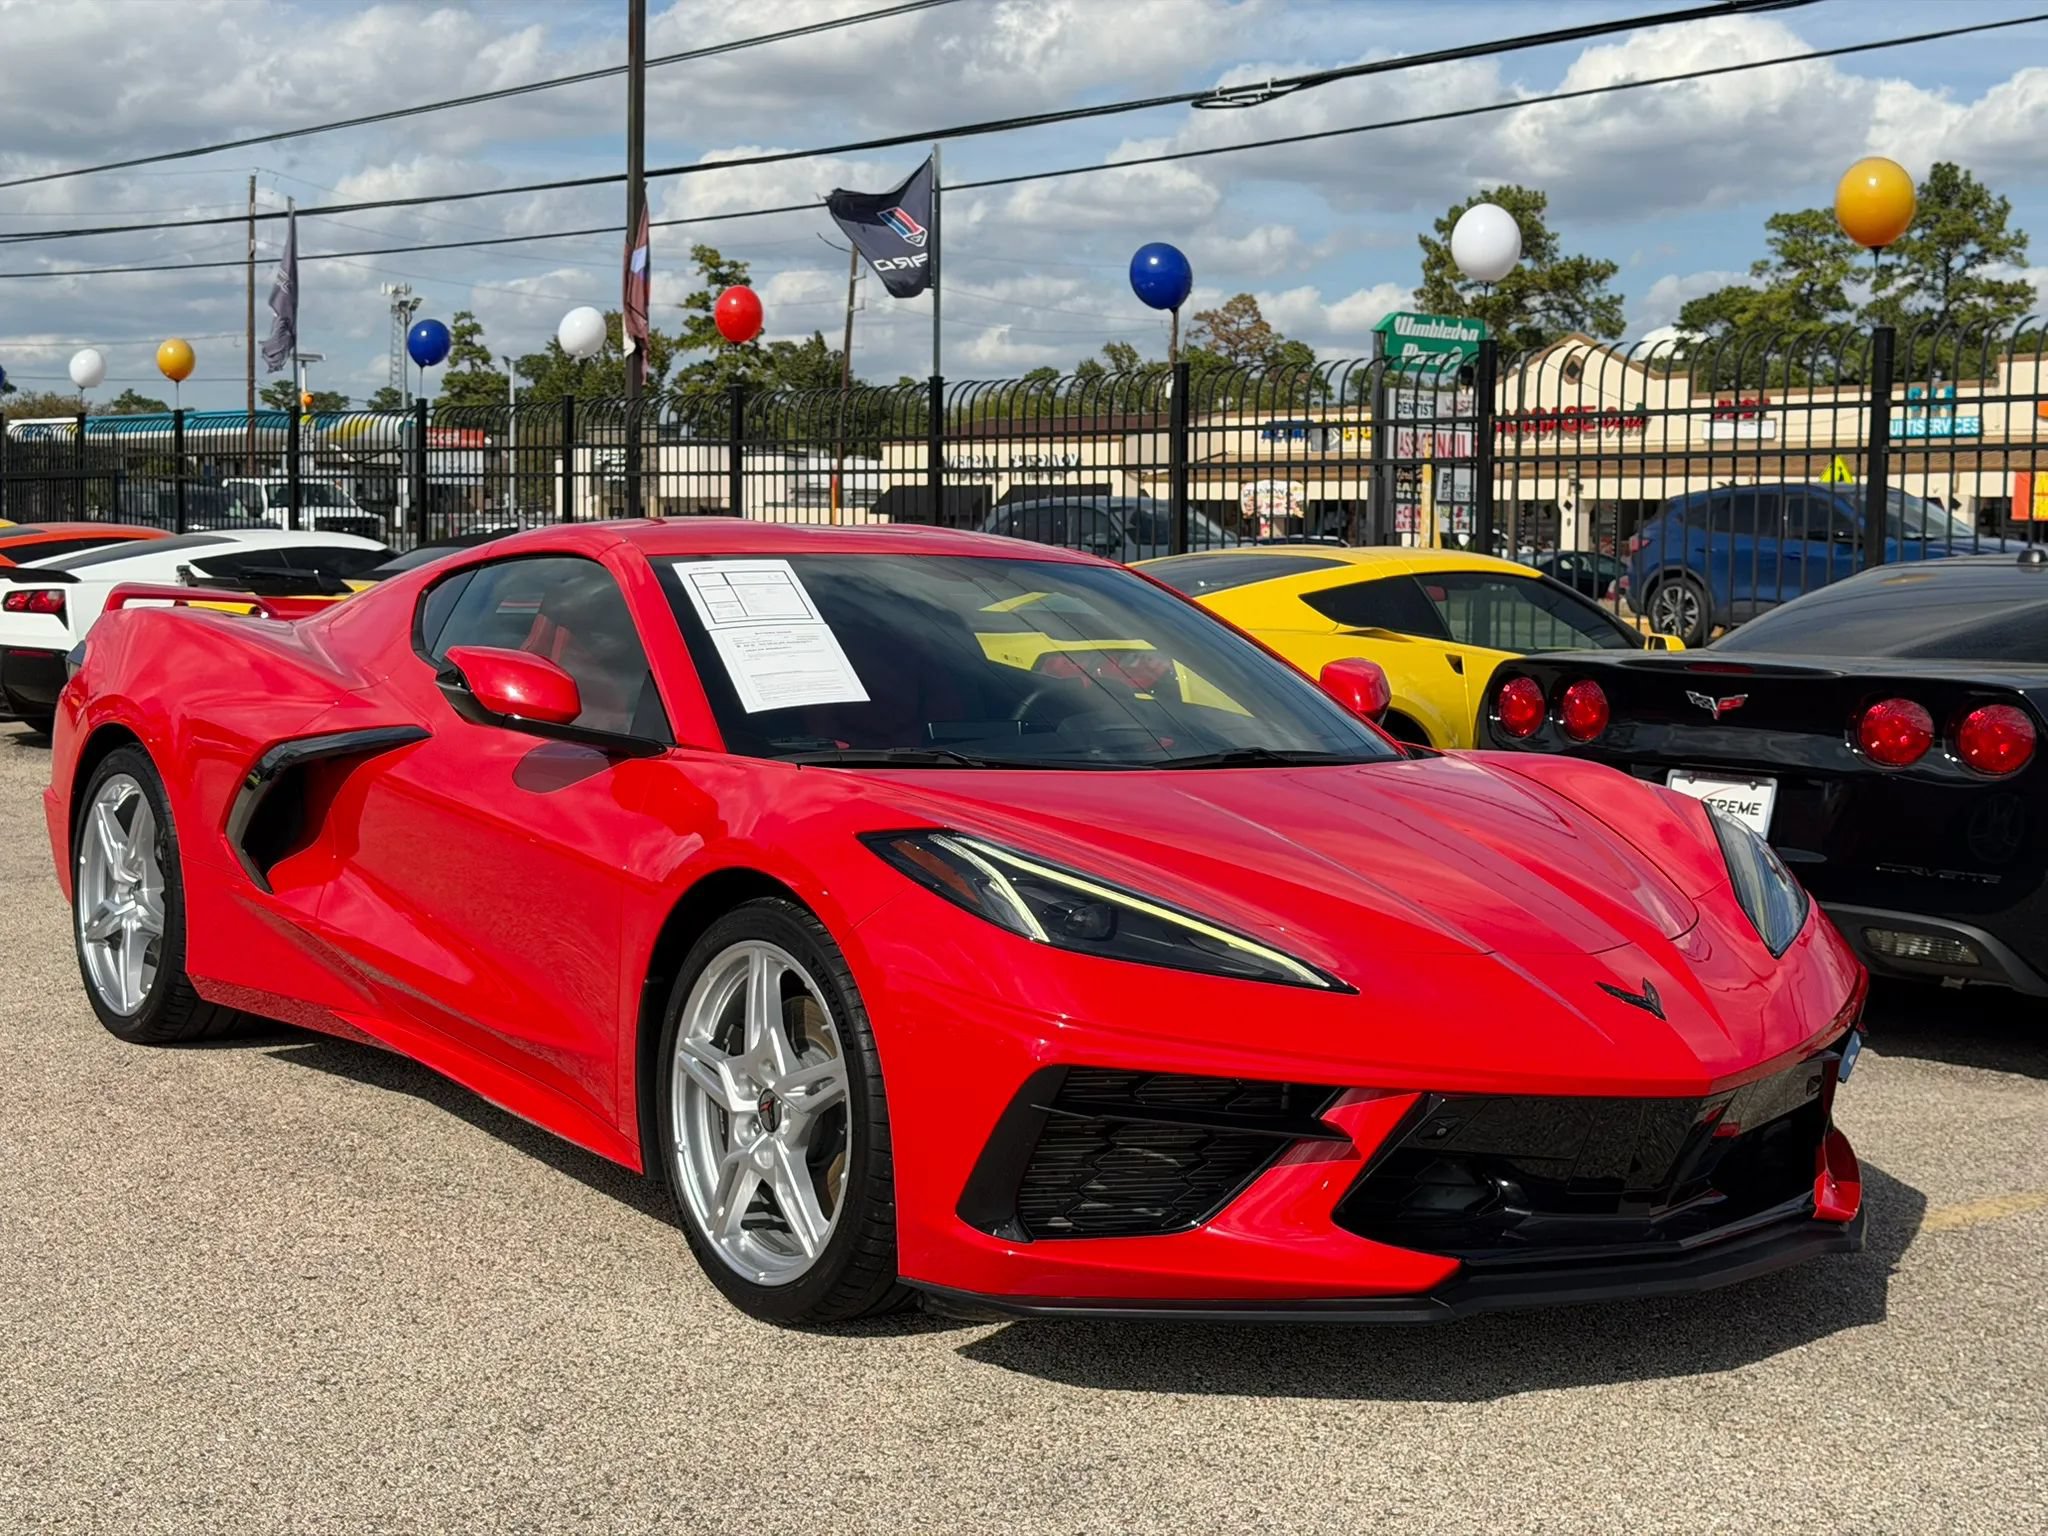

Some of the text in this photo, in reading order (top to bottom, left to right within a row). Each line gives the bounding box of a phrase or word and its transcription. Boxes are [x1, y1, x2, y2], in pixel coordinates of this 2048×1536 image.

[1394, 315, 1479, 342] Wimbledon
[1490, 405, 1597, 433] ASSAGE
[1889, 417, 1979, 437] ULTISERVCES
[1706, 798, 1762, 816] TREME
